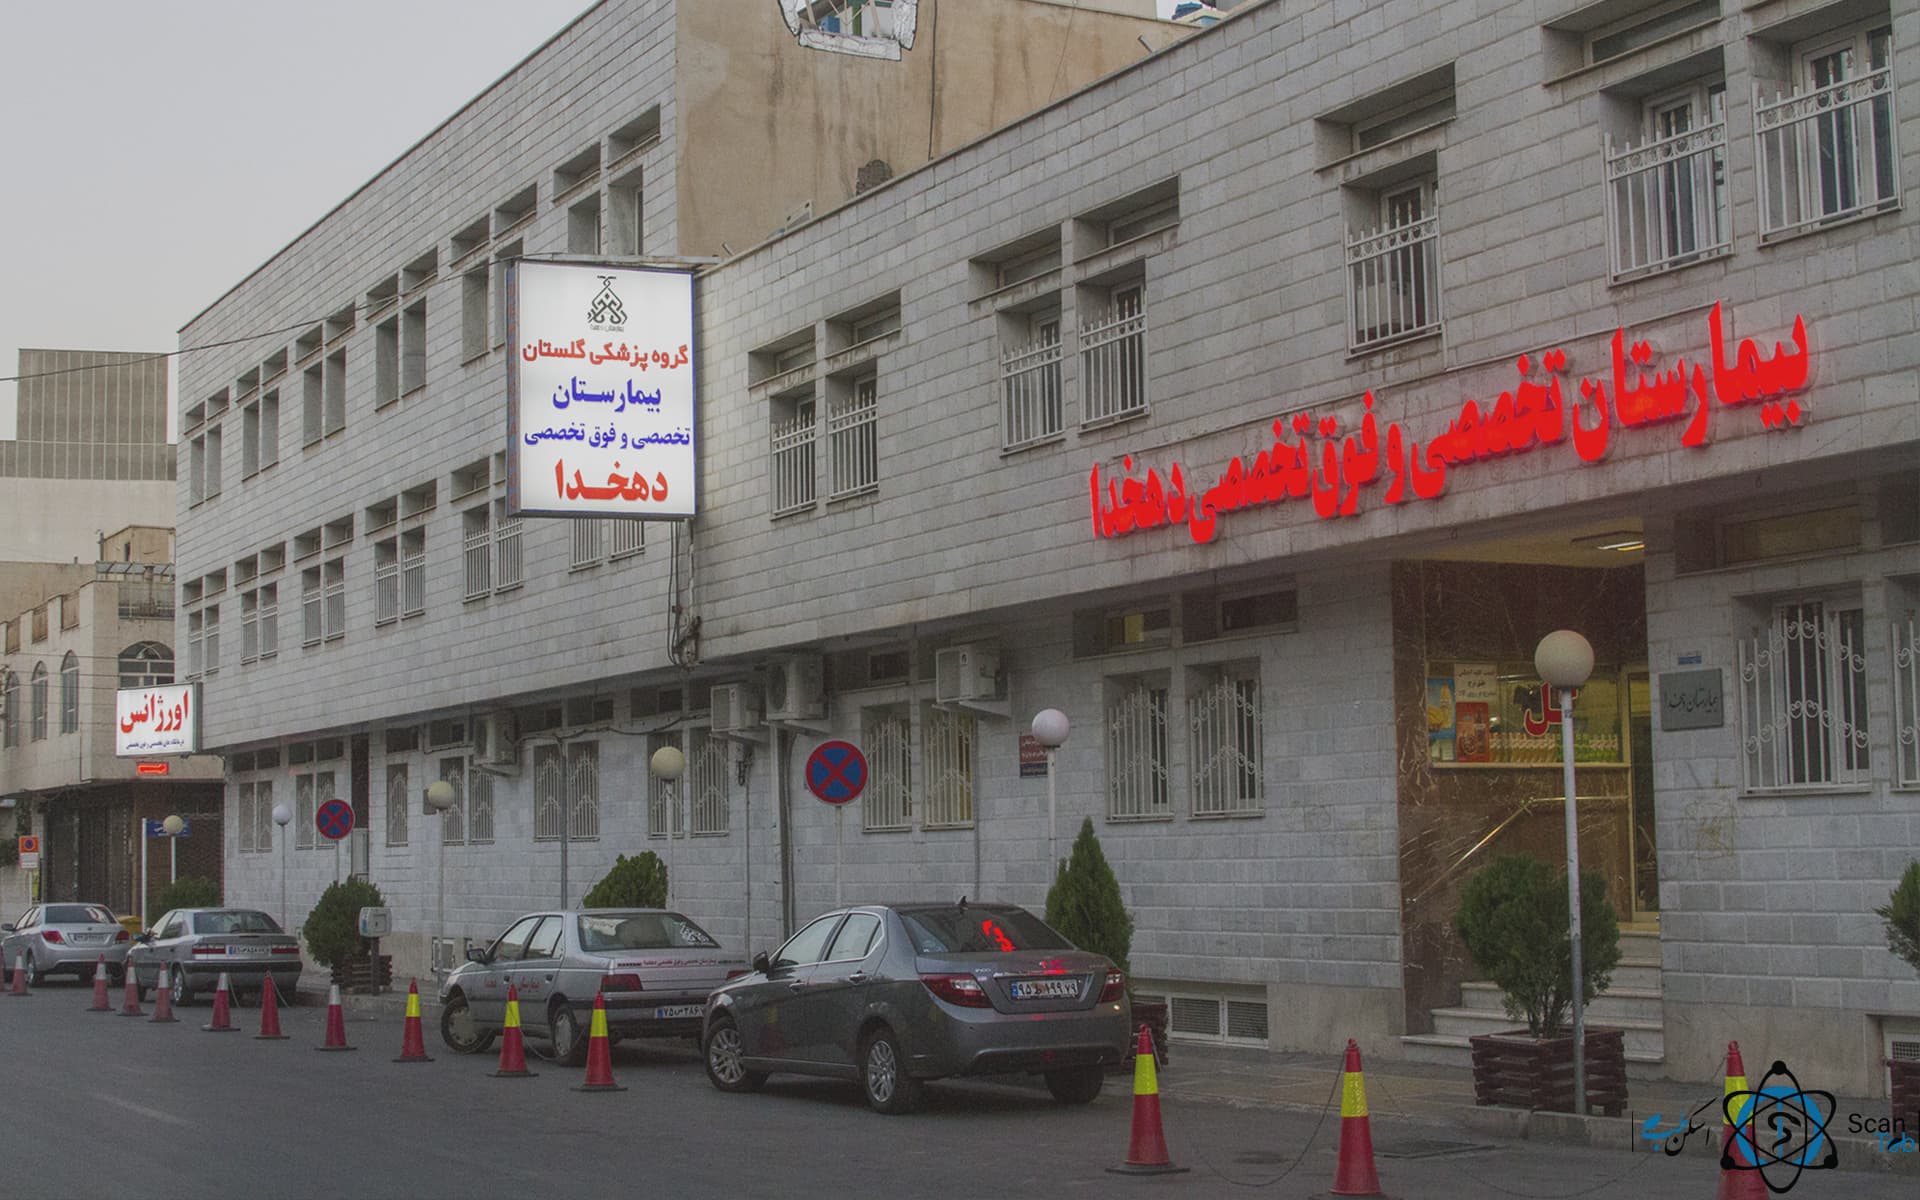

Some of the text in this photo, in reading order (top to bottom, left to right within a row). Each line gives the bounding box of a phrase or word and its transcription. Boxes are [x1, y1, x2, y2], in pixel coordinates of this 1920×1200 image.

[522, 338, 689, 371] گروه پزشکی گلستان
[552, 376, 662, 412] بیمارستان
[524, 422, 691, 450] تخصصی و فوق تخصصی
[1090, 300, 1810, 544] بیمارستان تخصصی و فوق تخصصی دهخدا
[554, 458, 669, 503] دهخدا
[119, 690, 189, 734] اورژانس
